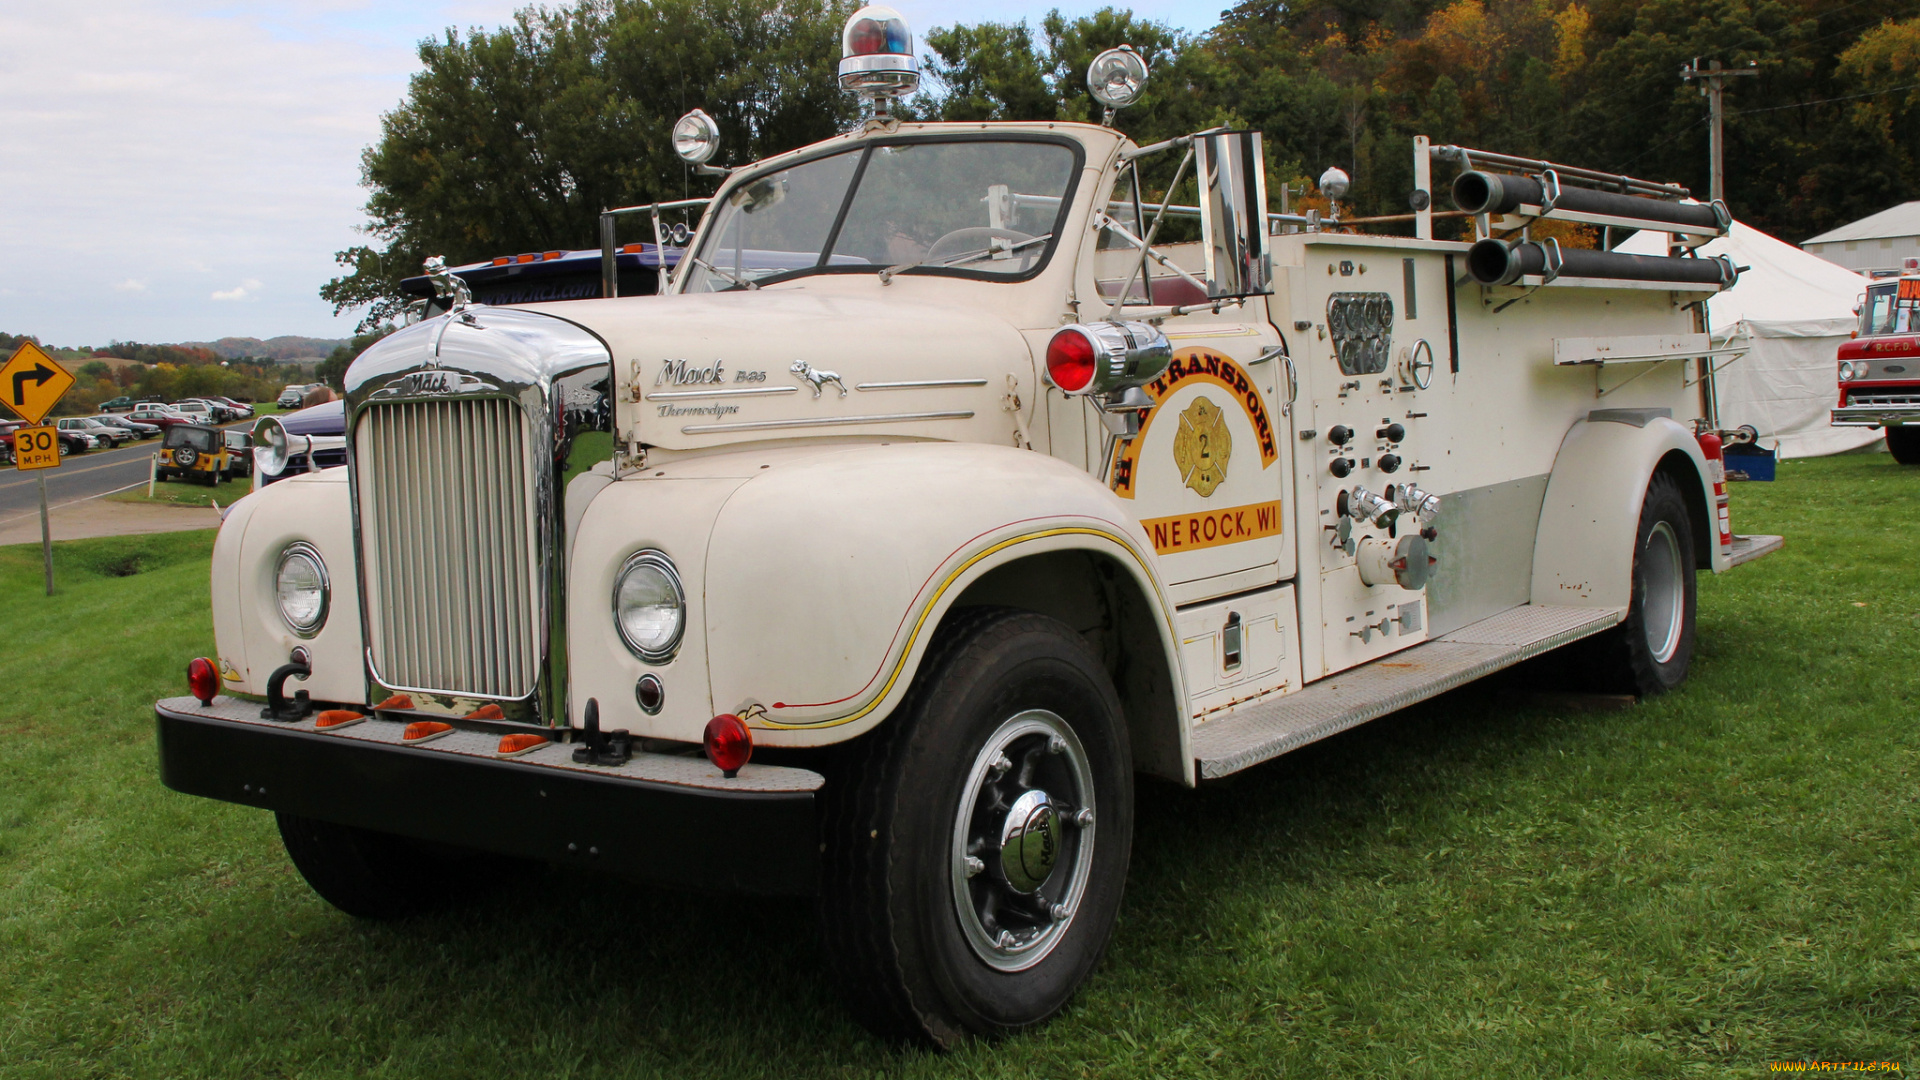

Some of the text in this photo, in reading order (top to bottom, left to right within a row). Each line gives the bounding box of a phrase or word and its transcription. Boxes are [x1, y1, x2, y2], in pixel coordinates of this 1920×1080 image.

[412, 373, 452, 393] Mack
[654, 358, 726, 387] Mack
[657, 402, 740, 420] Thermodyne
[1150, 353, 1275, 459] TRANSPORT
[19, 432, 51, 452] 30
[1198, 434, 1210, 459] 2
[1143, 505, 1277, 549] NE ROCK, WI
